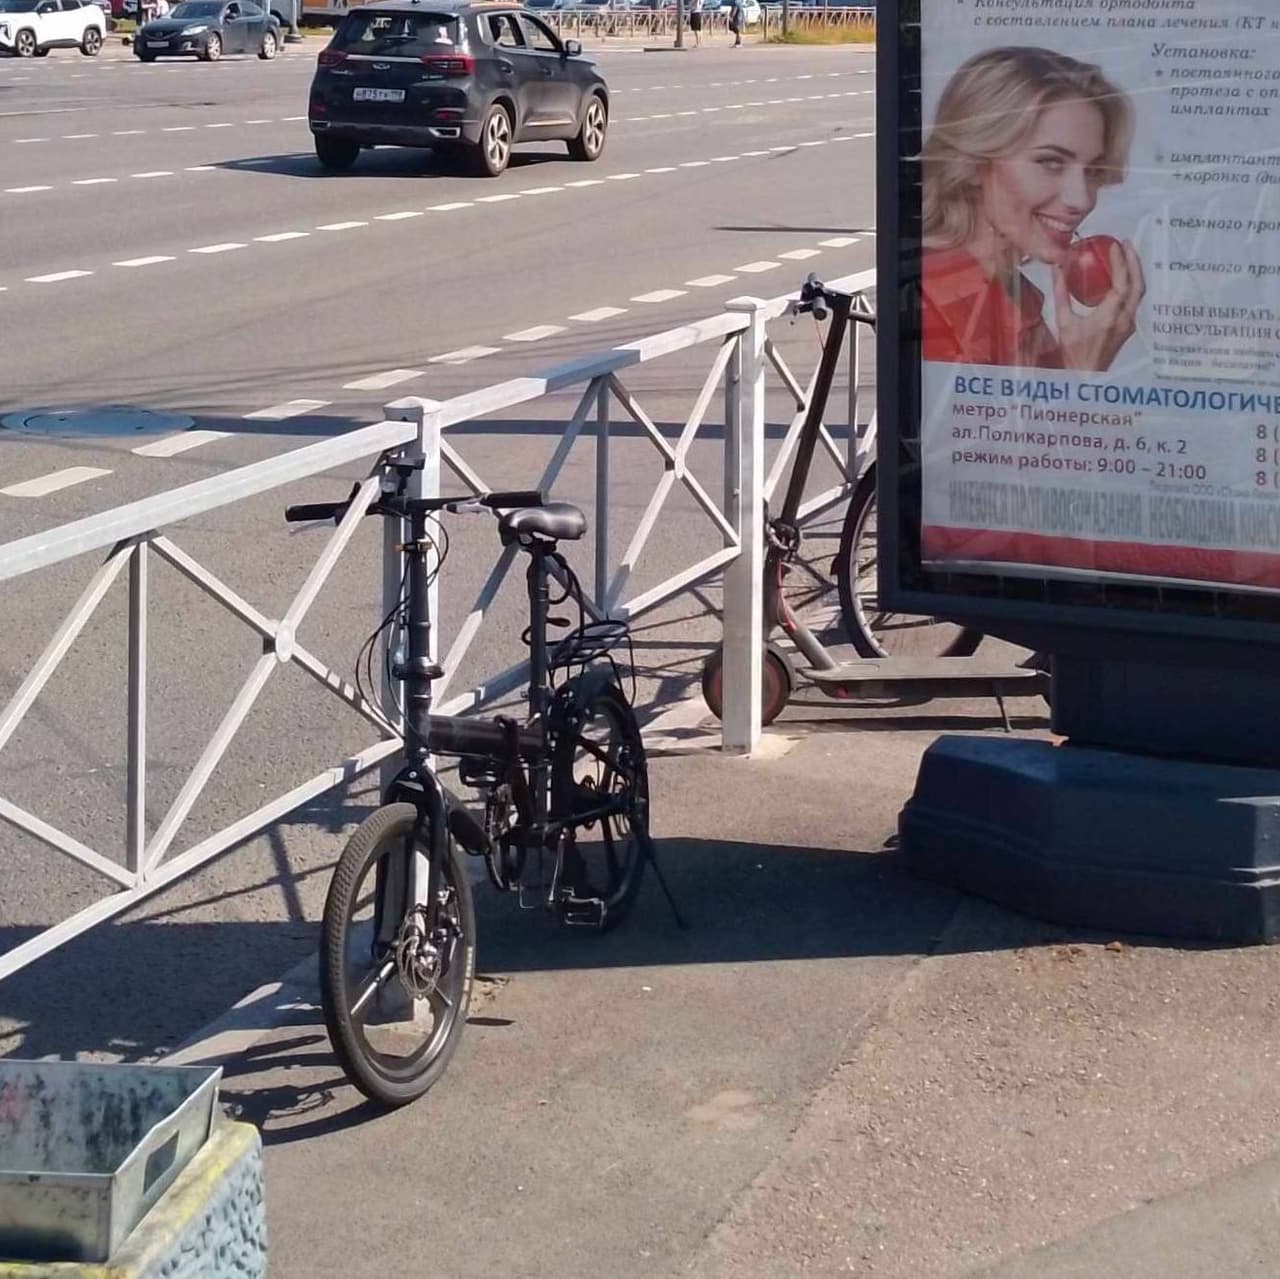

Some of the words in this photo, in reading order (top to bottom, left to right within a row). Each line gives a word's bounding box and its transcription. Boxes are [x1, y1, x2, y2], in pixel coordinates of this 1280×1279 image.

[986, 16, 1100, 28] составлением
[1107, 17, 1156, 29] плана
[1160, 18, 1228, 29] лечения
[1235, 17, 1266, 31] (КТ
[1151, 43, 1256, 60] Установка:
[1171, 85, 1241, 101] протеза
[1171, 104, 1271, 118] имплантах
[1153, 304, 1205, 319] ЧТОБЫ
[1209, 306, 1274, 322] ВЫБРАТЬ
[1153, 323, 1272, 341] КОНСУЛЬТАЦИЯ
[955, 375, 994, 396] ВСЕ
[1001, 378, 1070, 402] ВИДЫ
[952, 403, 1008, 420] метро
[1256, 424, 1267, 439] 8
[1113, 438, 1132, 452] д.
[1157, 440, 1171, 454] к.
[1177, 439, 1188, 455] 2
[1256, 447, 1267, 463] 8
[952, 450, 1014, 466] режим
[1018, 451, 1093, 473] работы:
[1098, 457, 1136, 475] 9:00
[1156, 462, 1207, 480] 21:00
[1255, 471, 1267, 486] 8
